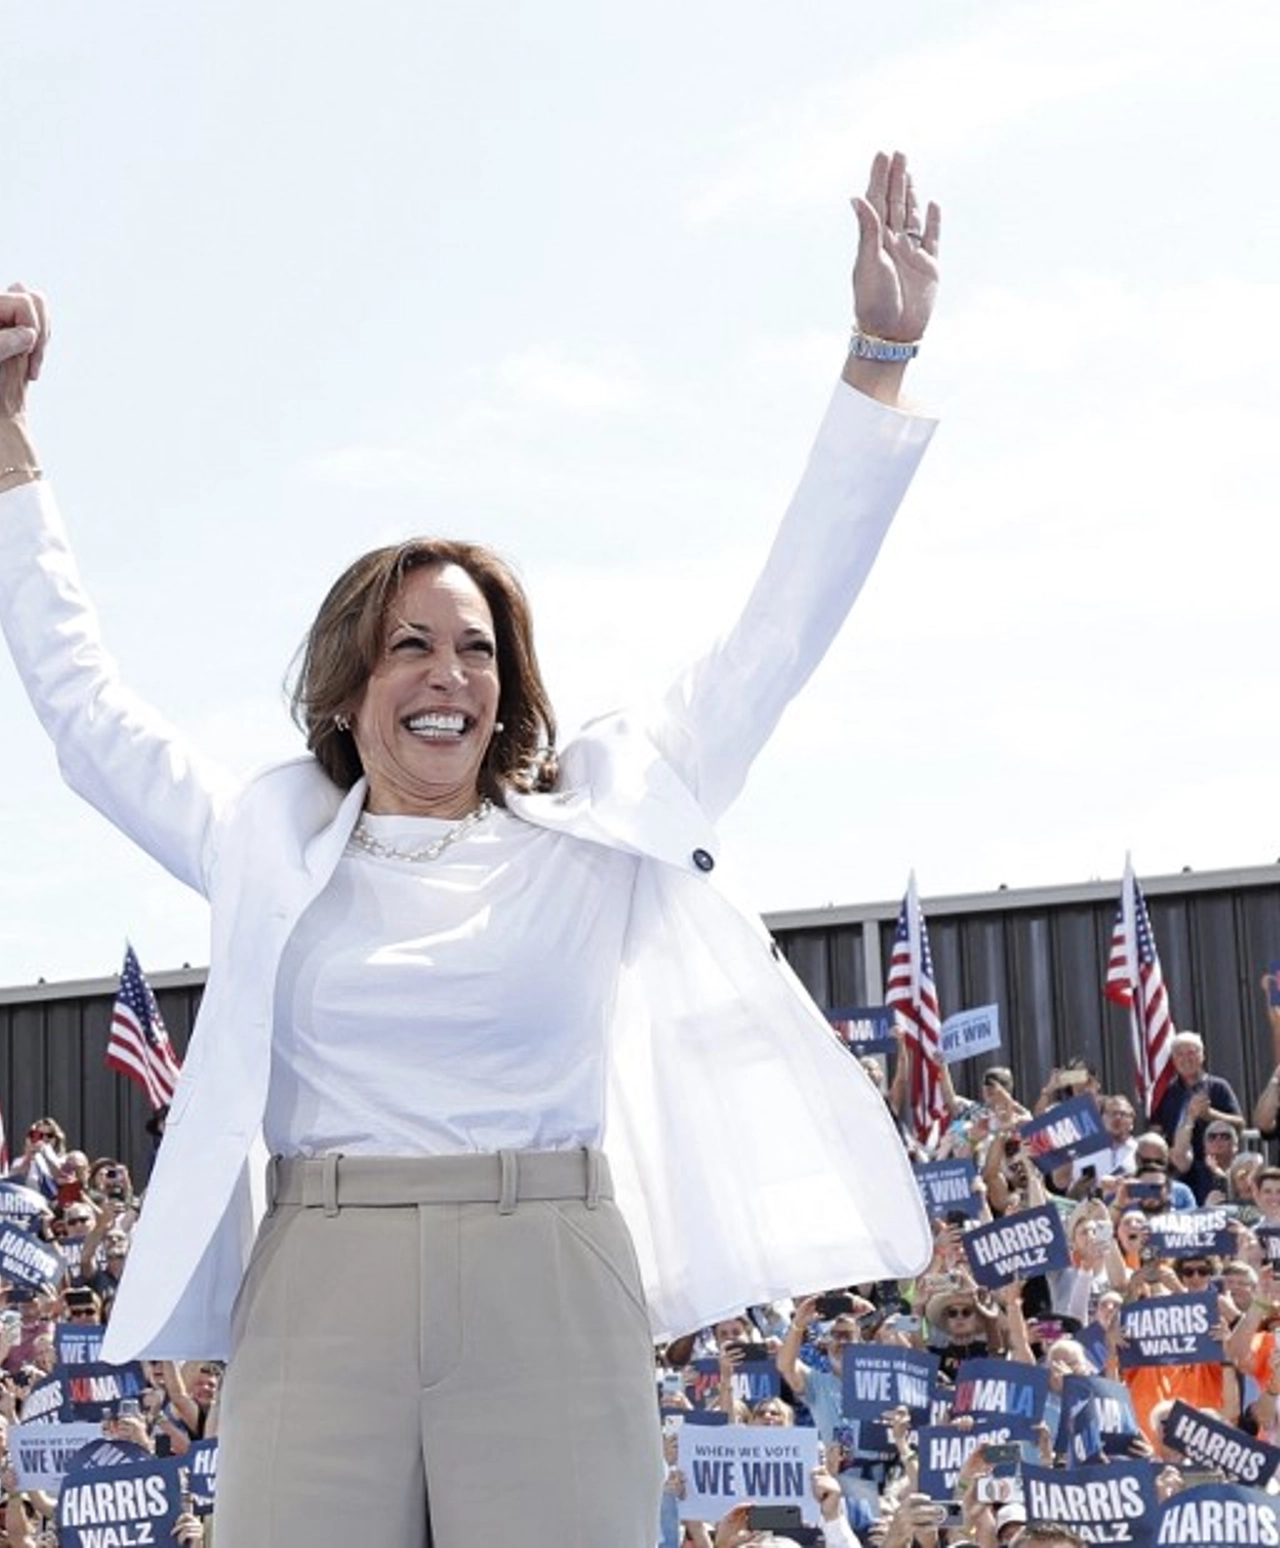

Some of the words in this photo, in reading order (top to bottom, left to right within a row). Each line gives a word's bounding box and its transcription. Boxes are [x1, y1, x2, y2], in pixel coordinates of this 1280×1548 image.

[943, 1032, 961, 1051] WE
[963, 1020, 991, 1044] WIN
[930, 1177, 970, 1203] WIN
[1150, 1209, 1227, 1236] HARRIS
[973, 1216, 1054, 1266] HARRIS
[1164, 1232, 1216, 1249] WALZ
[2, 1256, 42, 1285] WALZ
[994, 1247, 1048, 1276] WALZ
[1126, 1304, 1208, 1338] HARRIS
[60, 1342, 86, 1364] WE
[1140, 1335, 1197, 1356] WALZ
[70, 1372, 139, 1403] KAMALA
[855, 1370, 891, 1401] WE
[896, 1372, 928, 1409] WIN
[956, 1379, 1034, 1418] AMALA
[20, 1449, 49, 1474] WE
[694, 1445, 735, 1458] WHEN
[739, 1445, 760, 1458] WE
[764, 1445, 800, 1458] VOTE
[1174, 1414, 1266, 1482] HARRIS
[692, 1460, 736, 1497] WE
[742, 1461, 804, 1497] WIN
[62, 1475, 169, 1527] HARRIS
[1030, 1476, 1145, 1522] HARRIS
[79, 1522, 155, 1548] WALZ
[1070, 1522, 1132, 1544] ALZ
[1157, 1500, 1280, 1547] HARRIS
